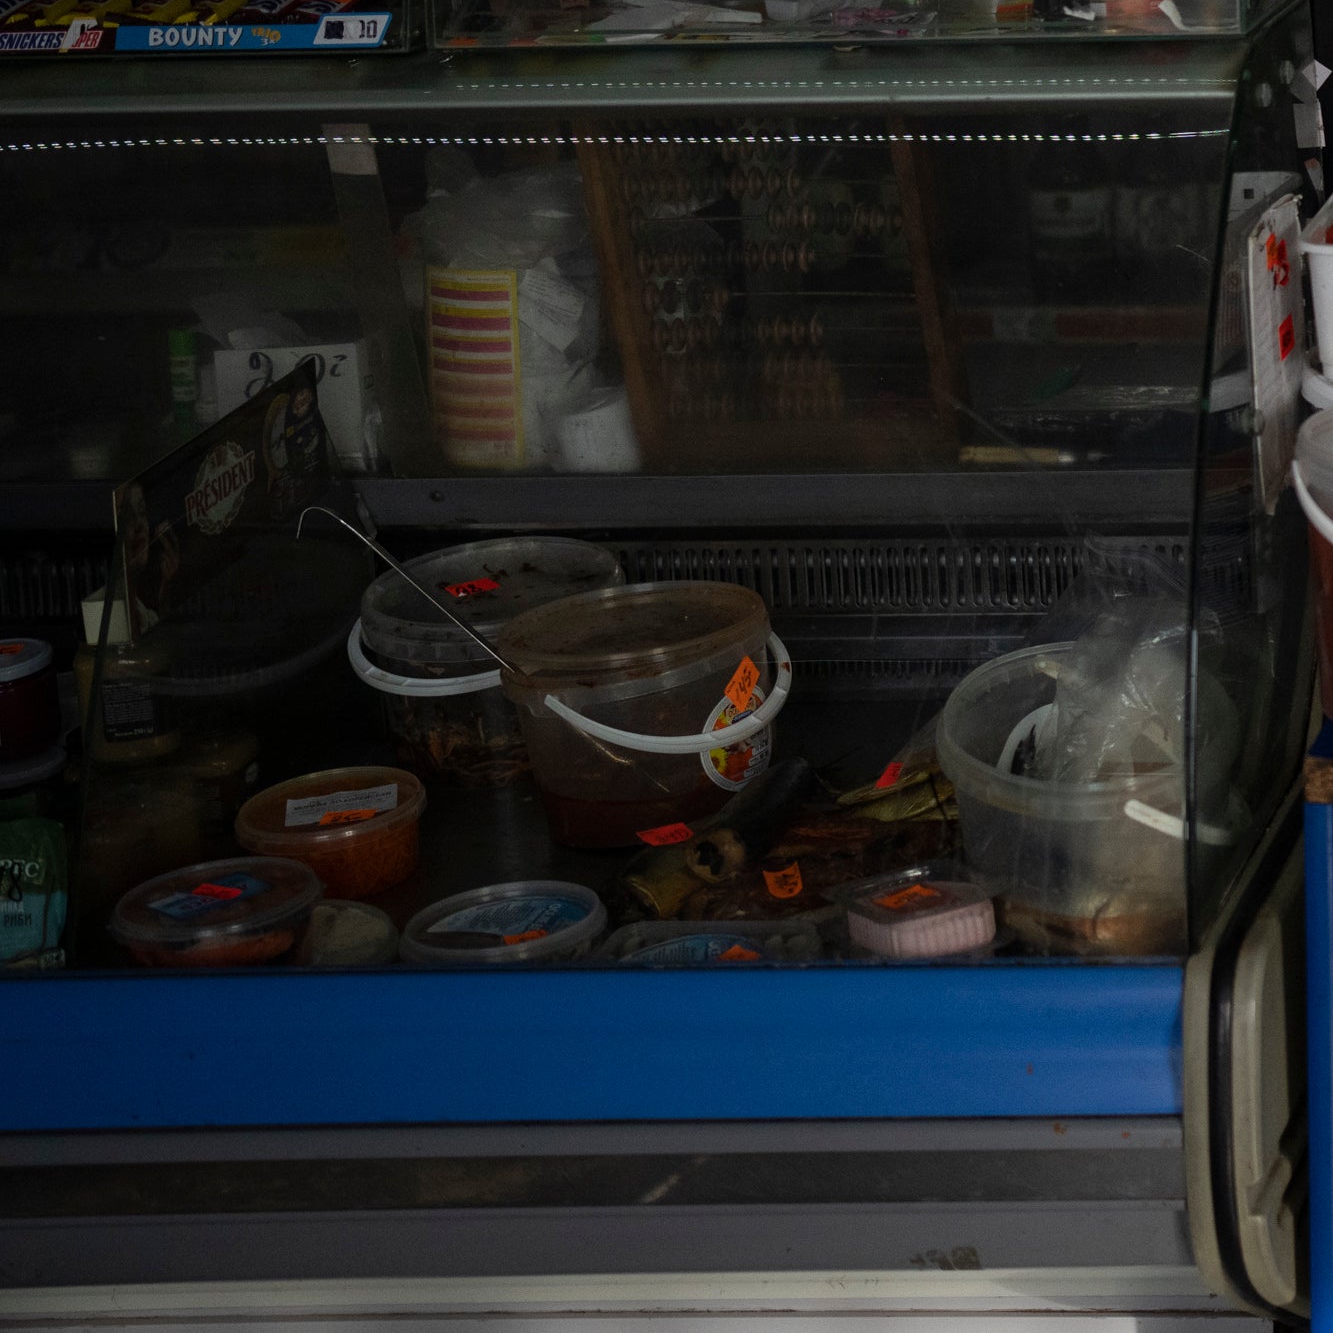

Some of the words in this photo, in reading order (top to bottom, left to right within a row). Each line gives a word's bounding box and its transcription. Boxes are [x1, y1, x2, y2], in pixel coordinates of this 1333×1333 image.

[0, 32, 64, 49] SNICKERS
[147, 26, 244, 48] BOUNTY
[250, 26, 281, 42] TRIO
[186, 450, 255, 522] PRÉSIDENT
